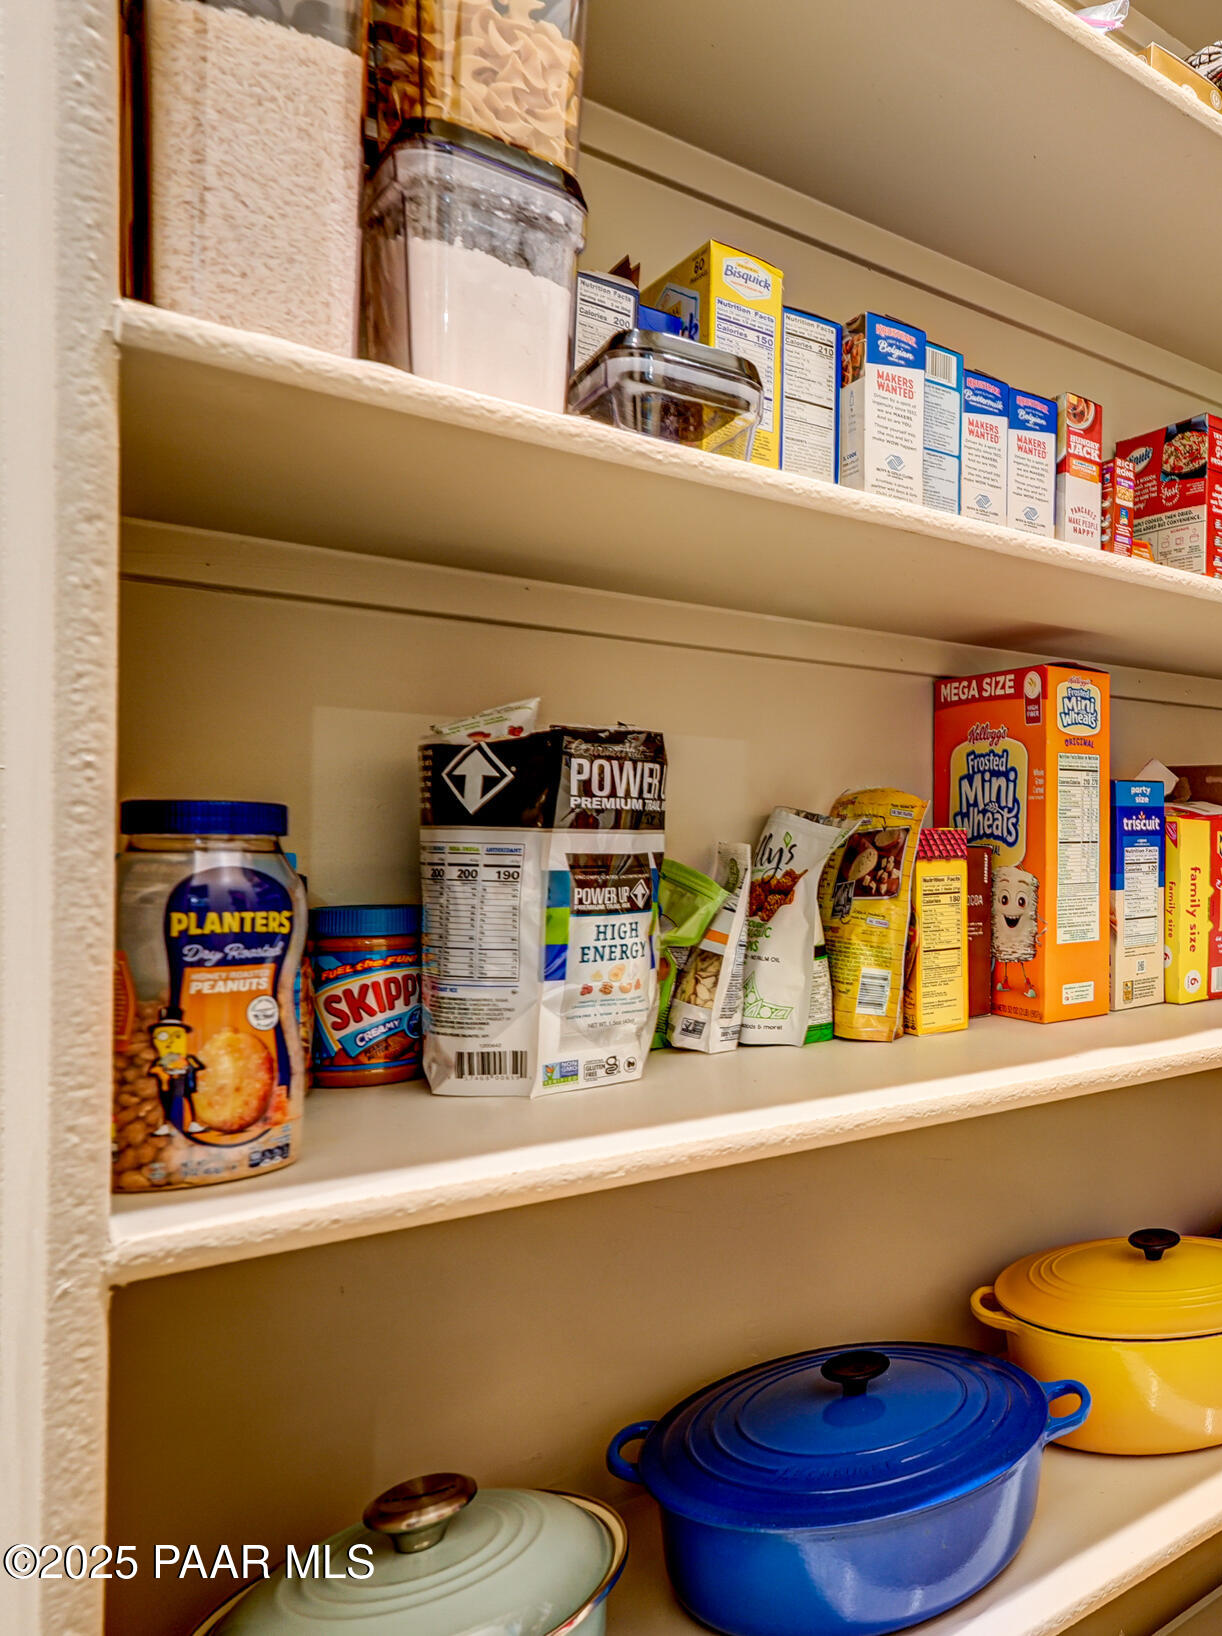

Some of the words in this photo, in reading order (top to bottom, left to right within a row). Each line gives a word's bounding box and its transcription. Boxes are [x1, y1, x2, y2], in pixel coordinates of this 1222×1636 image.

[724, 264, 771, 291] Bisquick
[755, 335, 774, 347] 150
[876, 369, 914, 389] MAKERS
[877, 380, 914, 400] WANTED
[968, 417, 999, 434] MAKERS
[968, 427, 999, 444] WANTED
[1016, 434, 1046, 450] MAKERS
[1069, 434, 1100, 449] HUNGRY
[1017, 443, 1046, 460] WANTED
[1068, 444, 1100, 461] JACK
[1116, 459, 1134, 471] RICE
[1072, 526, 1094, 538] HAPPY
[941, 680, 979, 702] MEGA
[982, 674, 1015, 697] SIZE
[1068, 688, 1090, 698] Frosted
[1063, 697, 1095, 713] Mini
[1061, 711, 1097, 728] Wheats
[968, 722, 1008, 746] Kellogg's
[1064, 738, 1094, 748] ORIGINAL
[968, 752, 1007, 771] Frosted
[570, 758, 660, 799] POWER
[961, 771, 1016, 812] Mini
[1131, 785, 1151, 795] party
[570, 797, 643, 810] PREMIUM
[1135, 795, 1149, 803] size
[956, 802, 1019, 842] Wheats
[1123, 816, 1160, 831] triscuit
[430, 868, 445, 879] 200
[457, 869, 478, 880] 200
[496, 870, 520, 881] 190
[574, 887, 617, 905] POWER
[618, 886, 630, 900] UP
[1166, 881, 1176, 916] family
[1186, 866, 1201, 918] family
[170, 911, 292, 937] PLANTERS
[594, 921, 639, 942] HIGH
[1167, 920, 1176, 938] size
[1190, 924, 1200, 953] size
[182, 943, 224, 967] Dry
[579, 941, 647, 964] ENERGY
[321, 964, 354, 981] FUEL
[189, 977, 269, 994] PEANUTS
[355, 1018, 401, 1047] CREAMY
